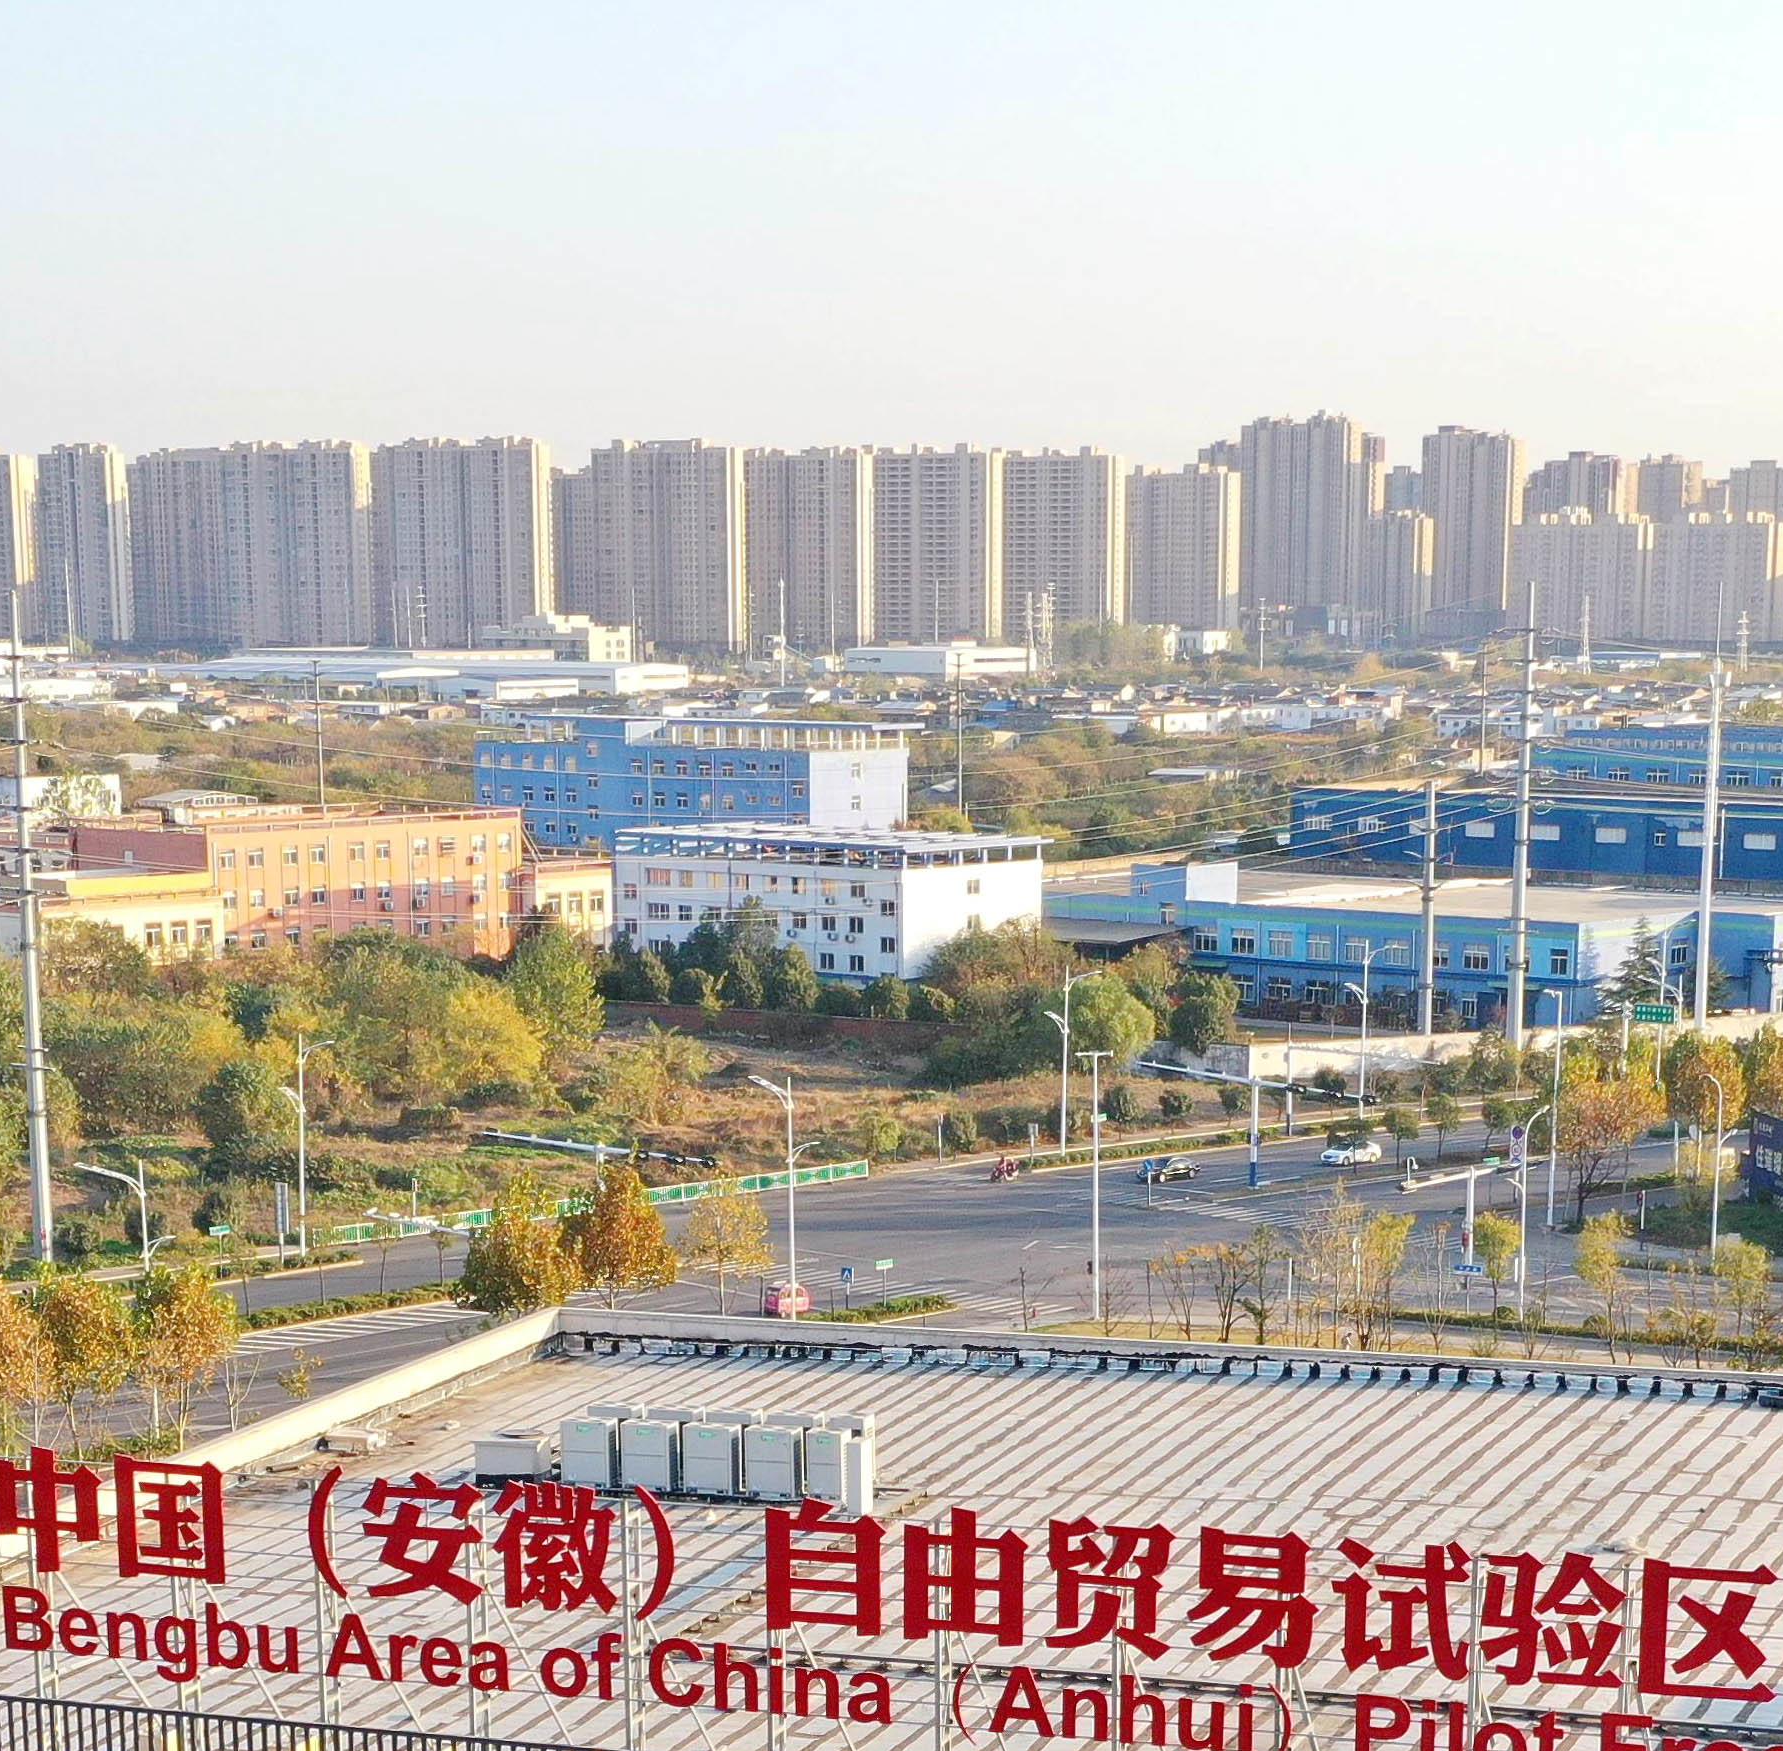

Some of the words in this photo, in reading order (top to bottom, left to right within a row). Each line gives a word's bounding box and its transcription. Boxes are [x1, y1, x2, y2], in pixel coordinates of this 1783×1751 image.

[3, 1585, 299, 1684] Bengbu
[327, 1613, 510, 1692] Area
[542, 1633, 622, 1701] of
[650, 1638, 893, 1725] China
